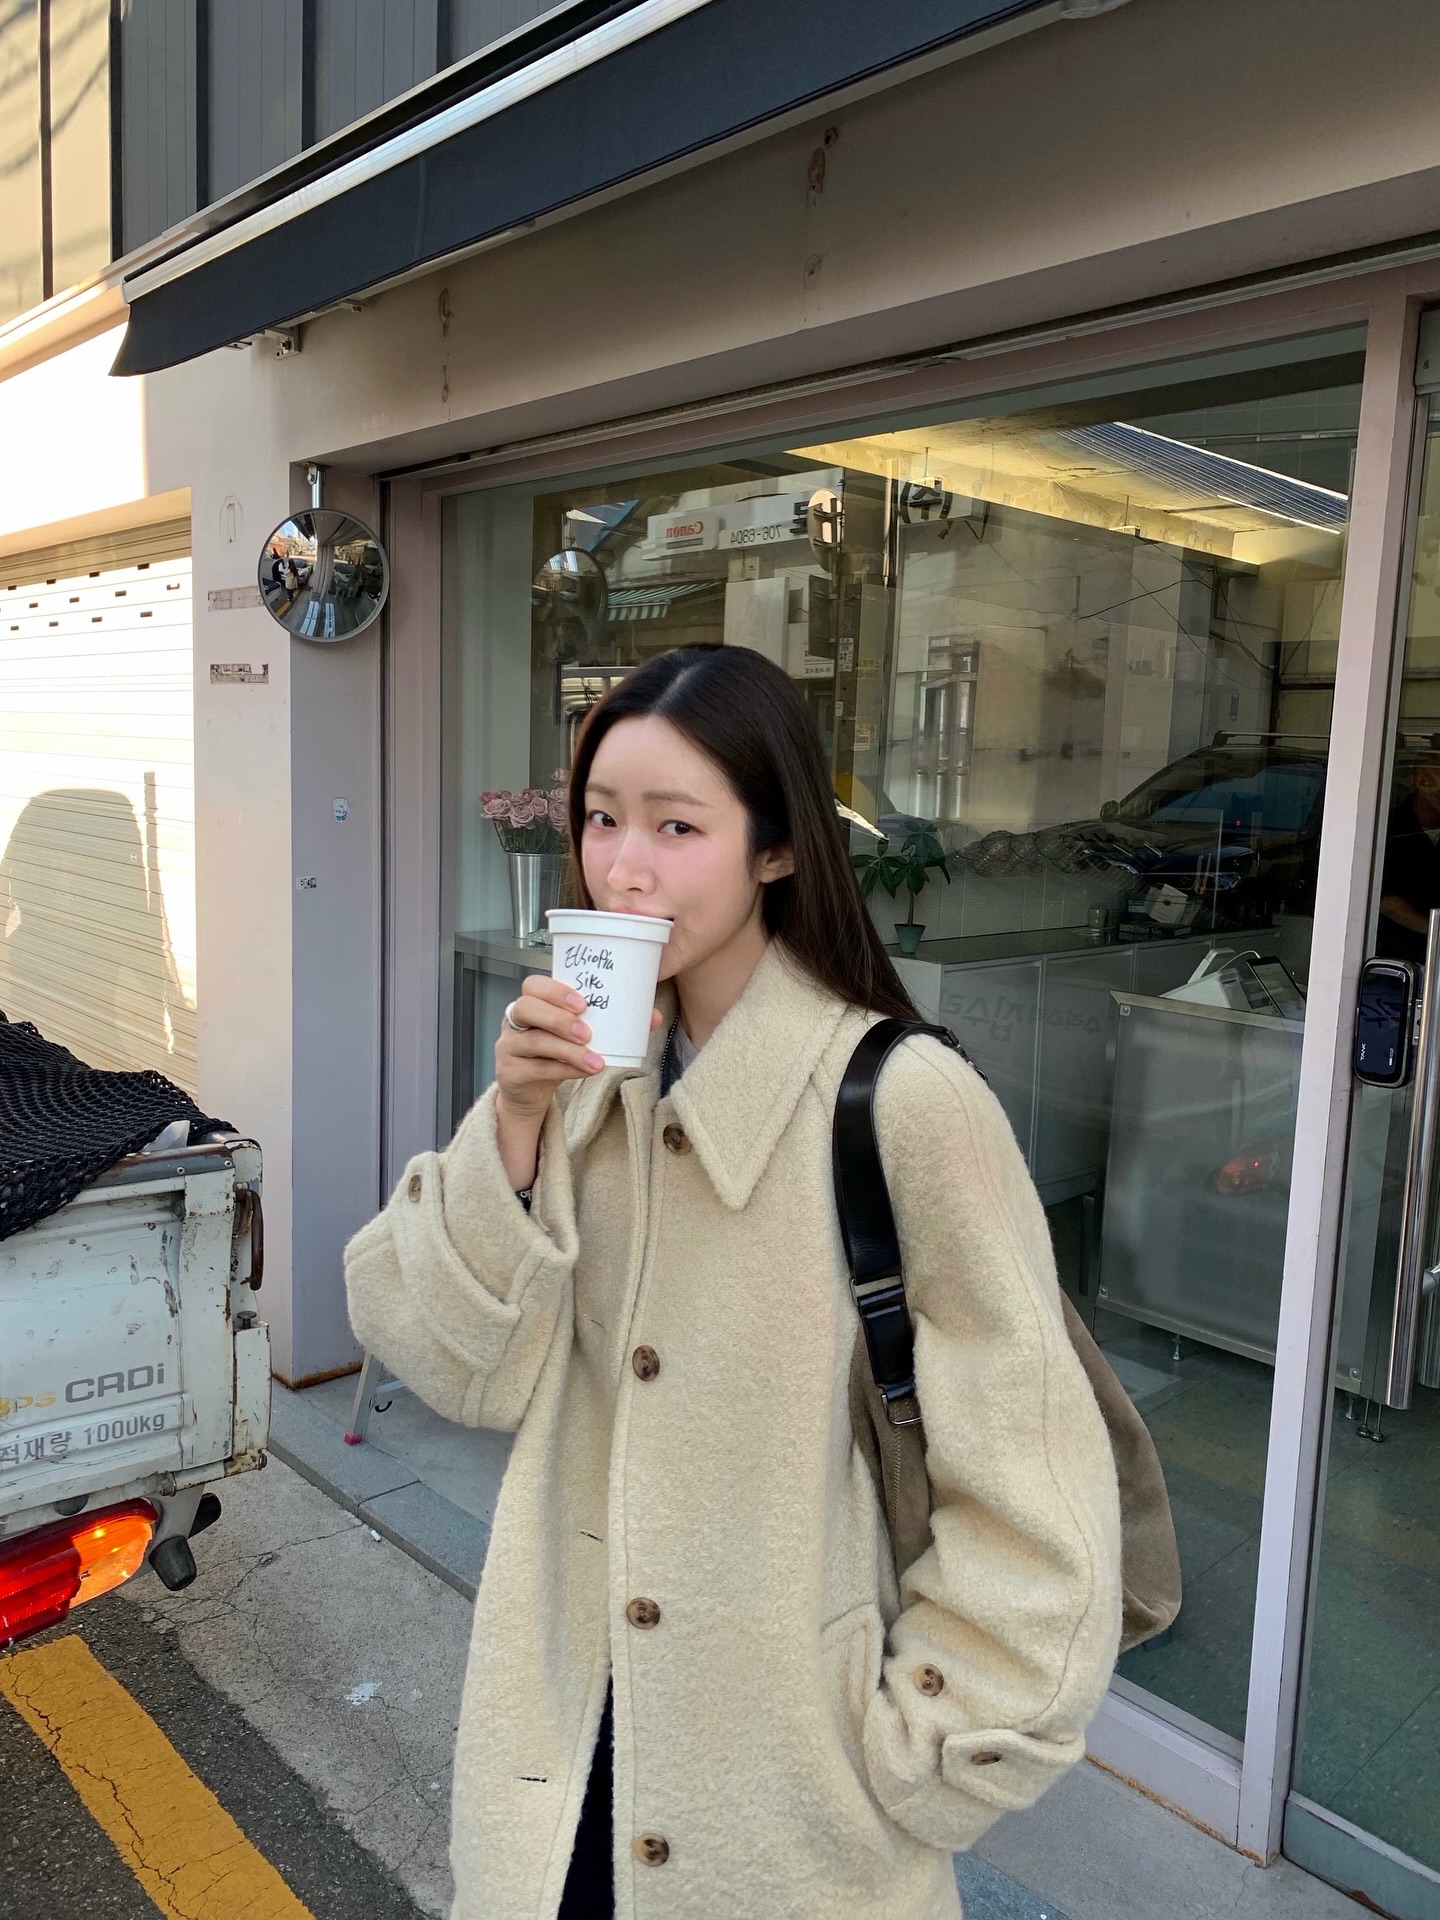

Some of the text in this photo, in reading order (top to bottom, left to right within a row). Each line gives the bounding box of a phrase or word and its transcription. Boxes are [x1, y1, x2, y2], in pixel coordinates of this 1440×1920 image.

[65, 1362, 165, 1404] CRDi
[0, 1412, 165, 1464] 적재량 1000kg
